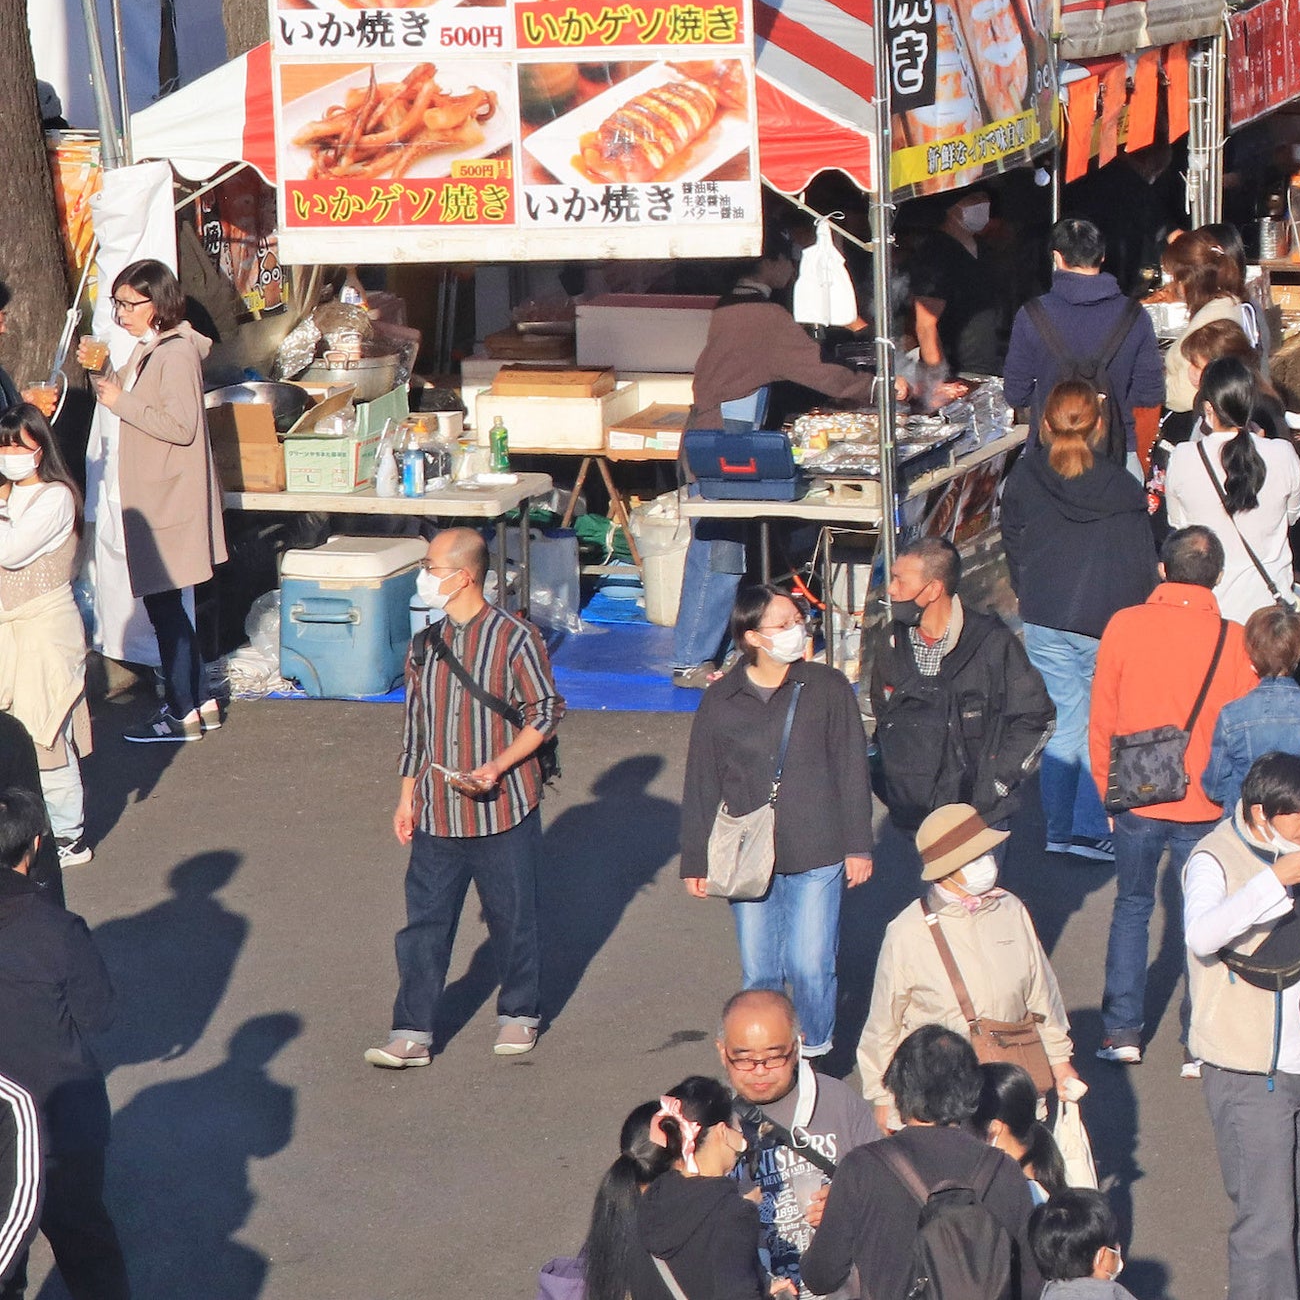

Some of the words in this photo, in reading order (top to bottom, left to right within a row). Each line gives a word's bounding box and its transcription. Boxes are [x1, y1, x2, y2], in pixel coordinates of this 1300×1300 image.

[278, 9, 431, 49] いか焼き
[440, 25, 503, 49] 500円
[522, 3, 739, 46] いかゲソ焼き
[460, 164, 495, 178] 500円
[681, 181, 720, 195] 醤油味
[292, 182, 511, 223] いかゲソ焼き
[524, 184, 676, 224] いか焼き
[682, 206, 745, 220] バター醤油
[775, 1204, 800, 1219] 1899
